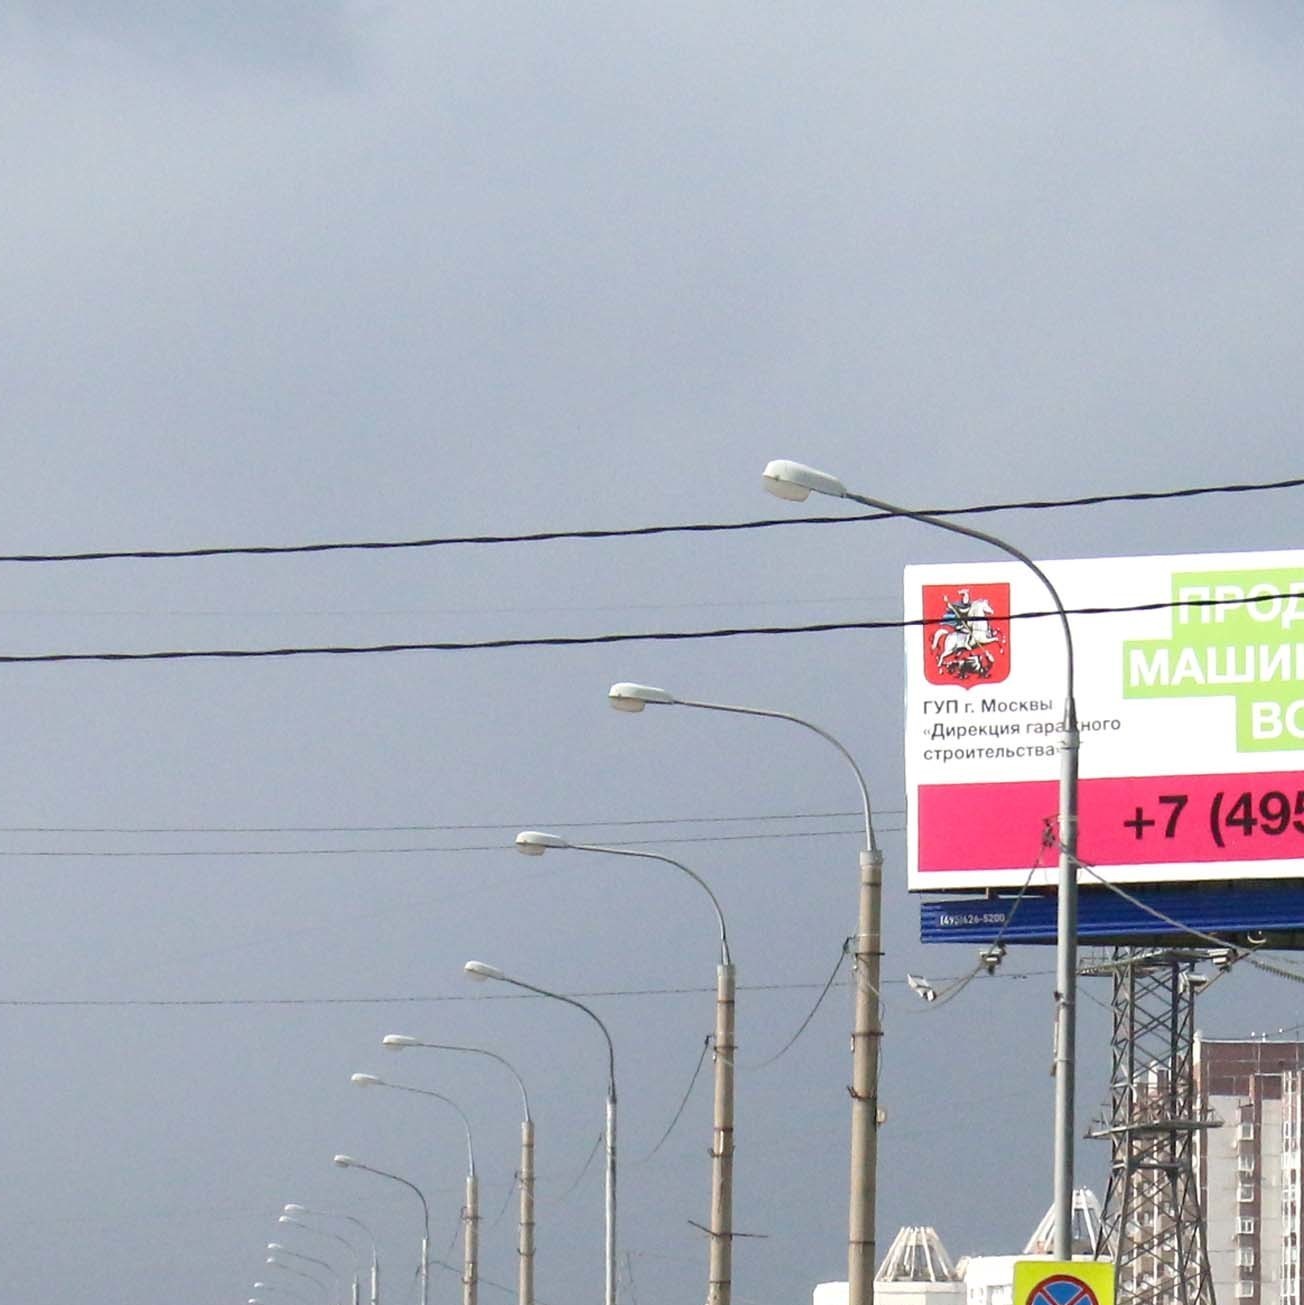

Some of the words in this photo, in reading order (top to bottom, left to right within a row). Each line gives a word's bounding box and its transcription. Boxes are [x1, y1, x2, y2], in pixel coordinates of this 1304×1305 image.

[923, 699, 959, 715] ГУП
[964, 702, 975, 714] г.
[981, 698, 1053, 713] Москвы
[923, 722, 1020, 740] «Дирекция
[1026, 718, 1121, 738] гараного
[1123, 795, 1189, 840] +7
